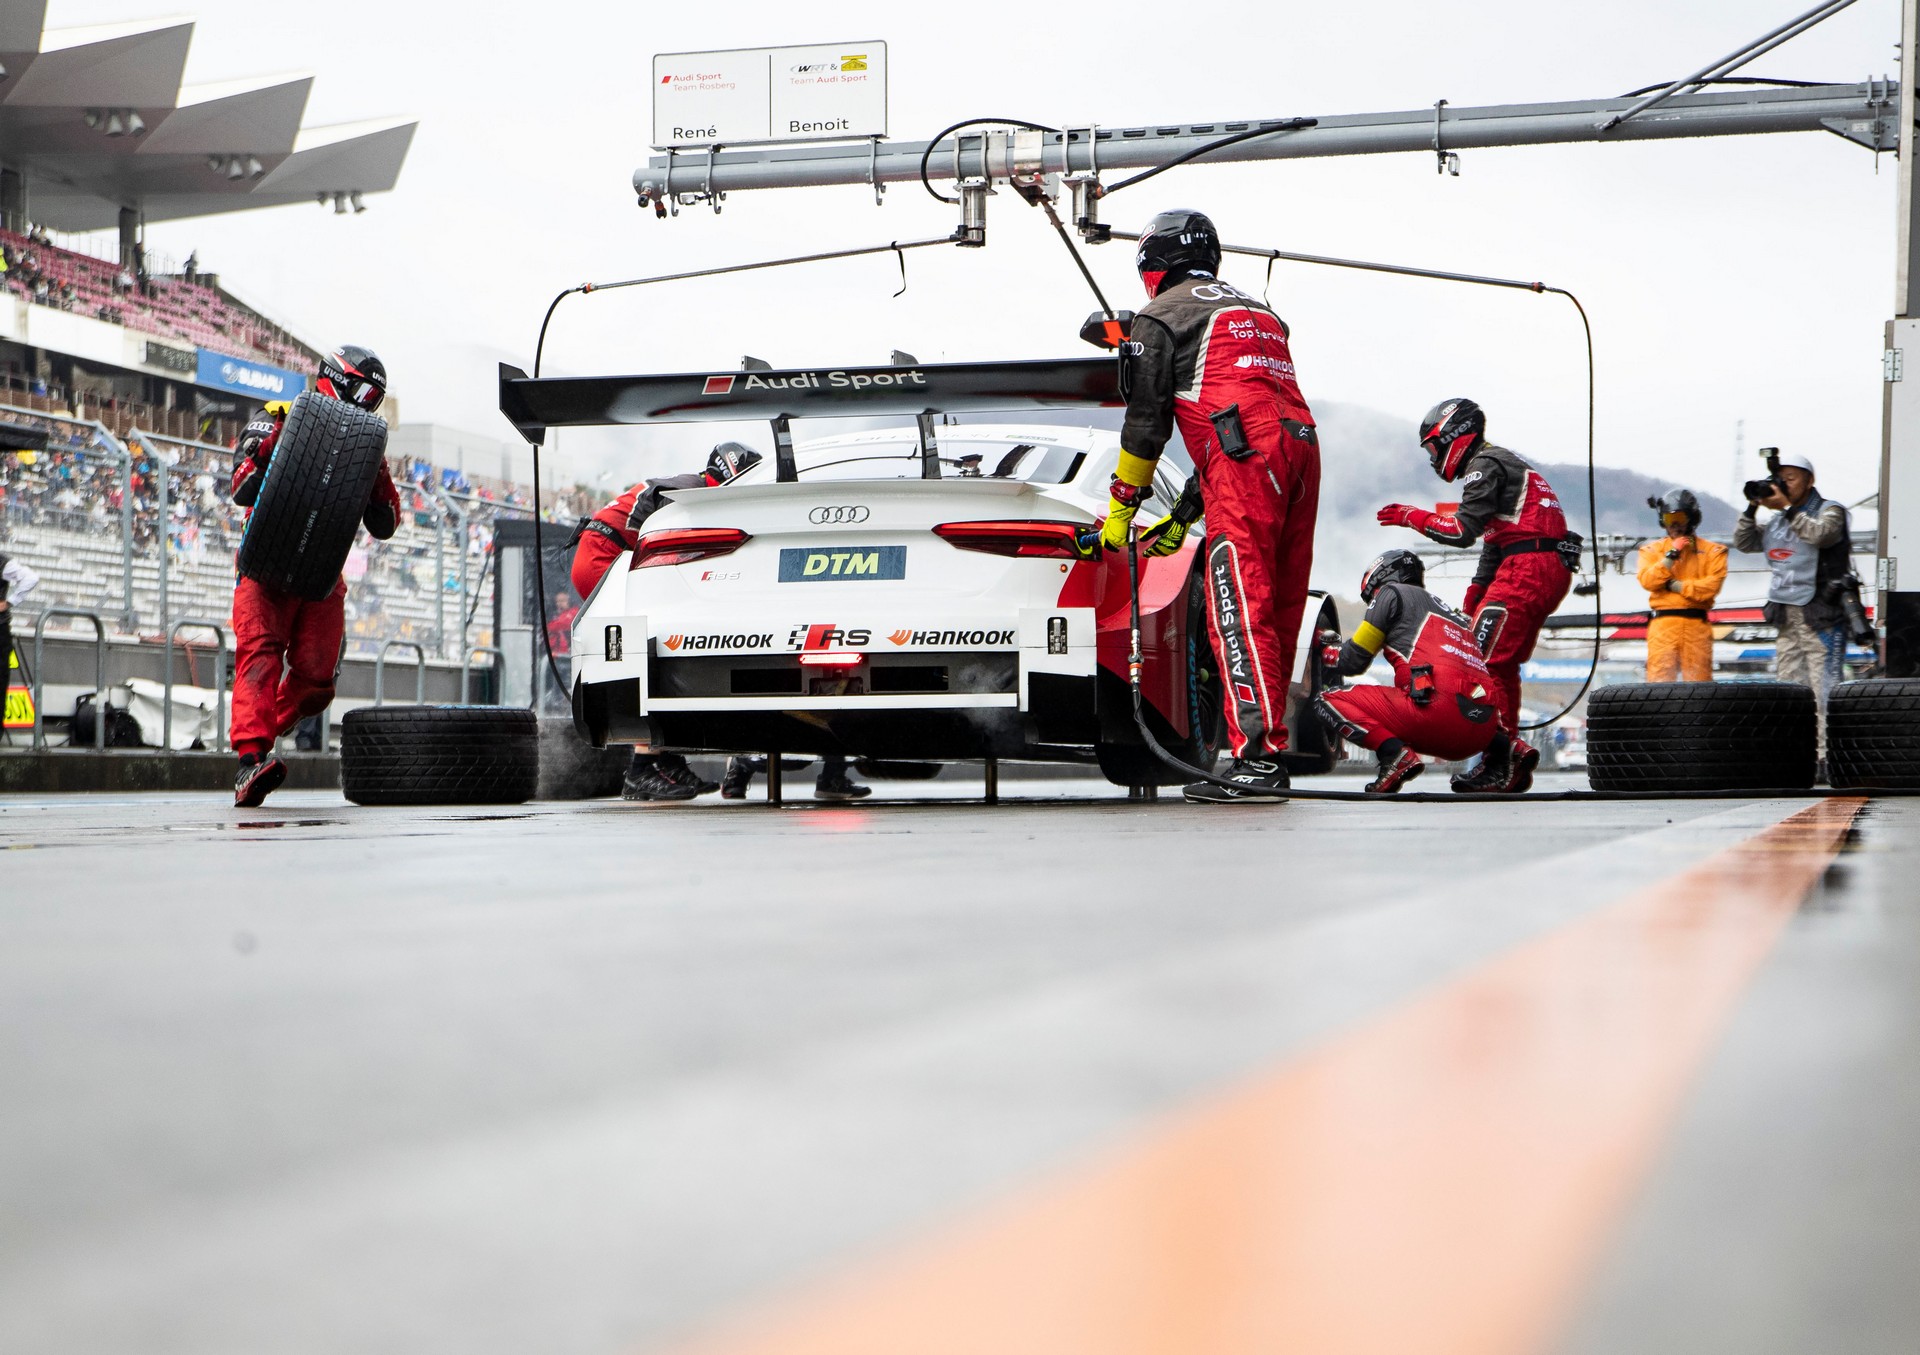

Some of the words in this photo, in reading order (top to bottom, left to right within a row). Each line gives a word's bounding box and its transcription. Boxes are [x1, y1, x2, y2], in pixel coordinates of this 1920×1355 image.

[830, 63, 838, 71] &
[673, 73, 694, 82] Audi
[696, 72, 722, 82] Sport
[790, 77, 814, 86] Team
[816, 76, 838, 84] Audi
[840, 74, 867, 83] Sport
[673, 84, 697, 92] Team
[699, 81, 736, 91] Rosberg
[673, 125, 717, 139] René
[789, 118, 849, 133] Benoit
[1228, 319, 1255, 331] Audi
[1230, 329, 1254, 340] Top
[238, 367, 284, 394] SUBARU
[323, 365, 351, 387] uvex
[744, 372, 820, 390] Audi
[827, 370, 926, 390] Sport
[1440, 417, 1474, 445] uvex
[714, 455, 732, 479] uve
[803, 552, 880, 576] DTM
[1214, 564, 1235, 626] Sport
[818, 629, 872, 647] RS
[1225, 631, 1246, 677] Audi
[1248, 760, 1266, 769] Sport
